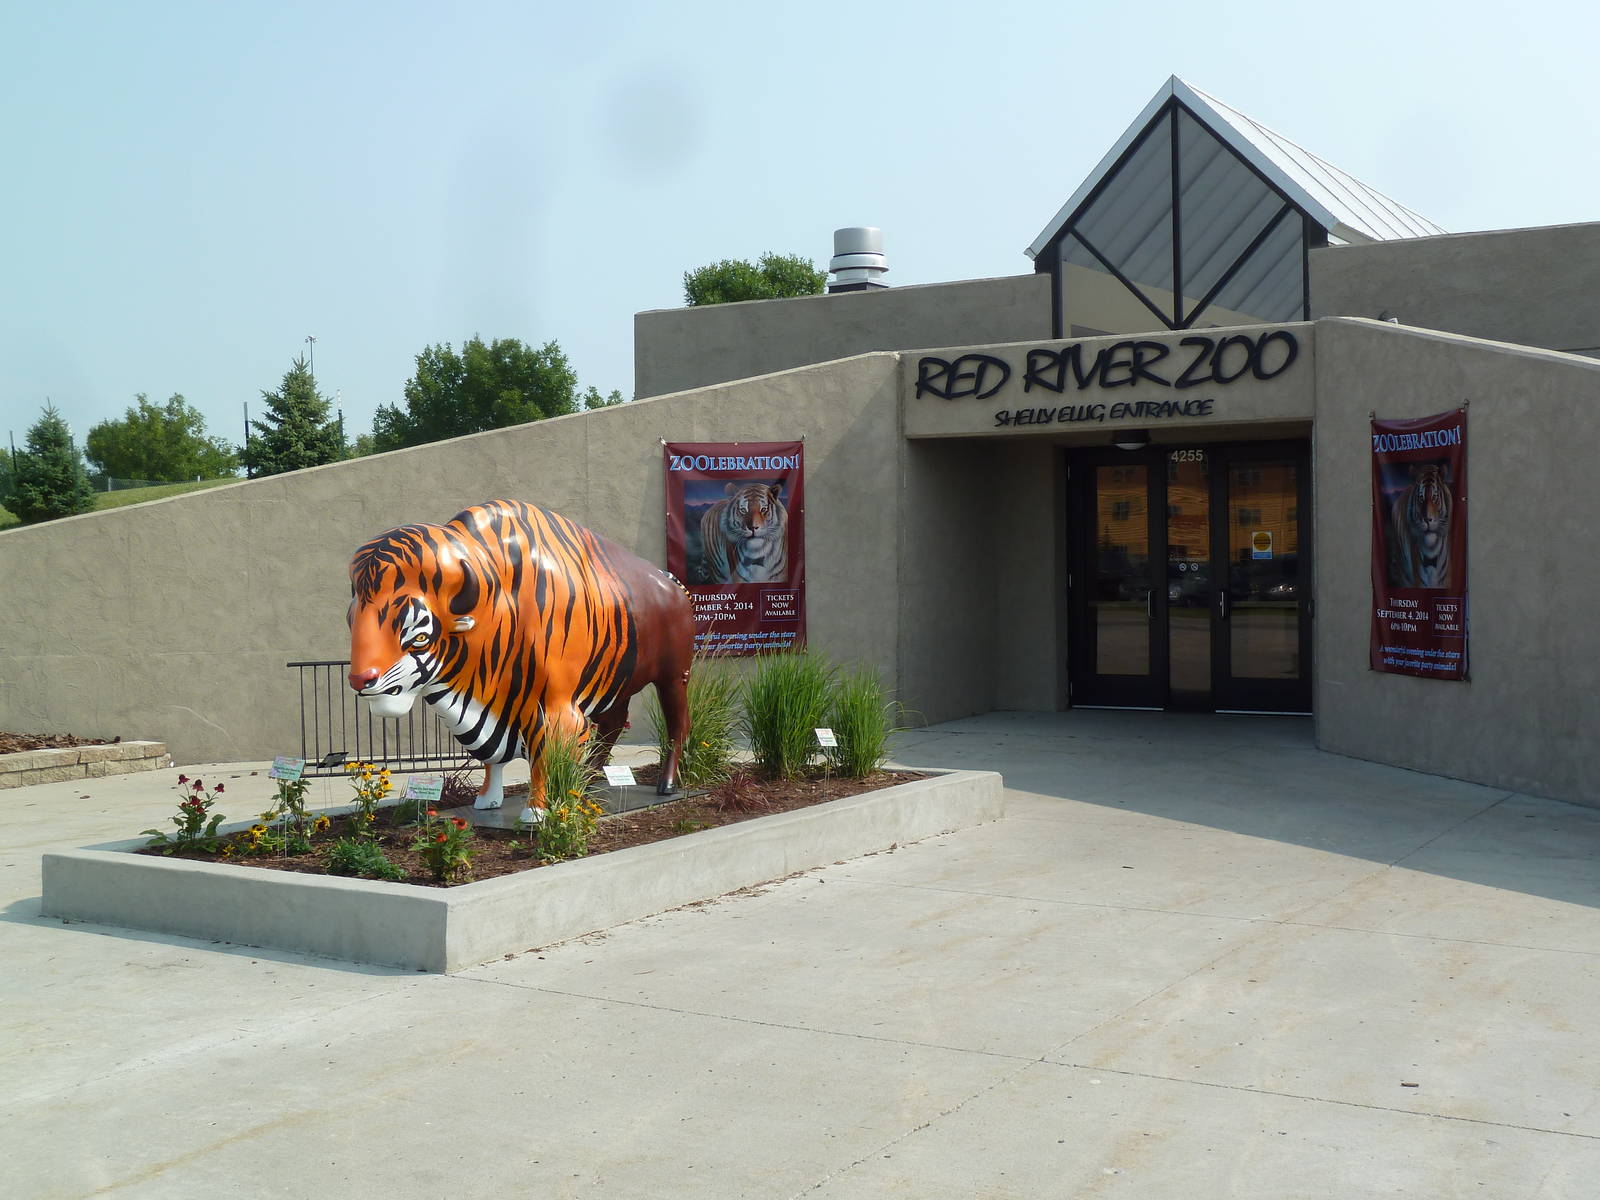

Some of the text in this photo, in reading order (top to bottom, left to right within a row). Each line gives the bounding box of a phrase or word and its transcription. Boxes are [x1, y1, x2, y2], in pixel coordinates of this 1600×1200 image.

[916, 330, 1298, 400] RED RIVER ZOO
[994, 408, 1056, 428] SHELLY
[1110, 399, 1215, 419] ENTRANCE
[1373, 425, 1462, 453] ZOOLEBRATION!
[669, 454, 800, 471] ZOOLEBRATION!
[1171, 450, 1203, 463] 4255
[692, 593, 737, 602] THURSDAY
[695, 603, 722, 611] EMBER
[733, 602, 753, 610] 2014
[1436, 604, 1458, 612] TICKETS
[1416, 611, 1429, 621] 2014
